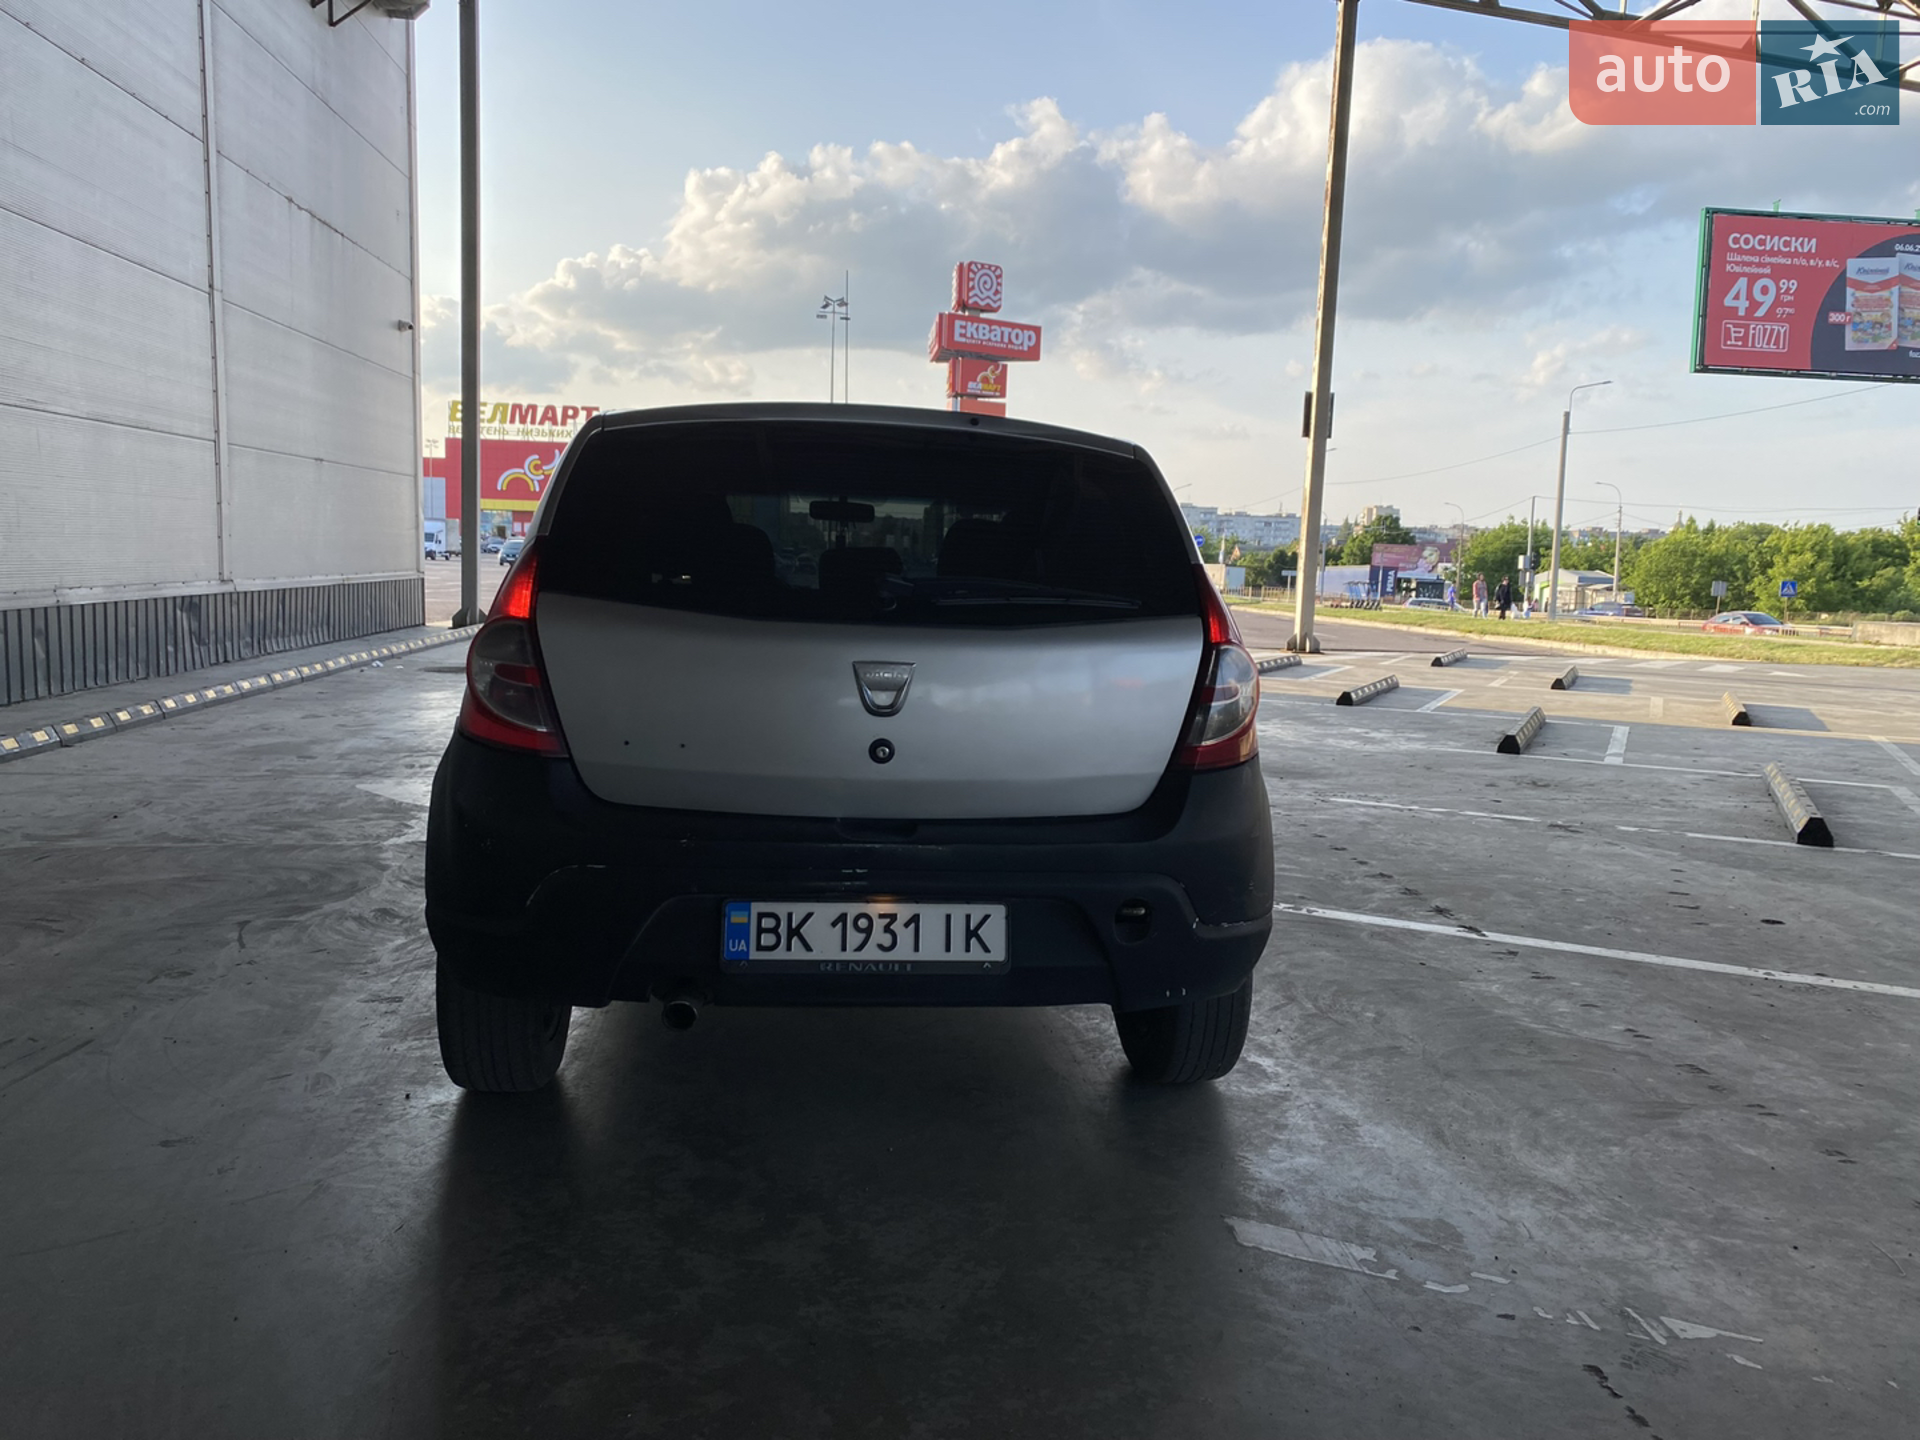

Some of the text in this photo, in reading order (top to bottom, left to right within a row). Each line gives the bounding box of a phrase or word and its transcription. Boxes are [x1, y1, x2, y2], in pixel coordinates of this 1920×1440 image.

[1727, 233, 1817, 253] СОСИСКИ
[1723, 276, 1798, 317] 49 99
[1828, 313, 1846, 322] 300
[1748, 324, 1788, 349] FOZZY
[755, 911, 993, 955] BK 1931 IK
[728, 938, 748, 952] UA
